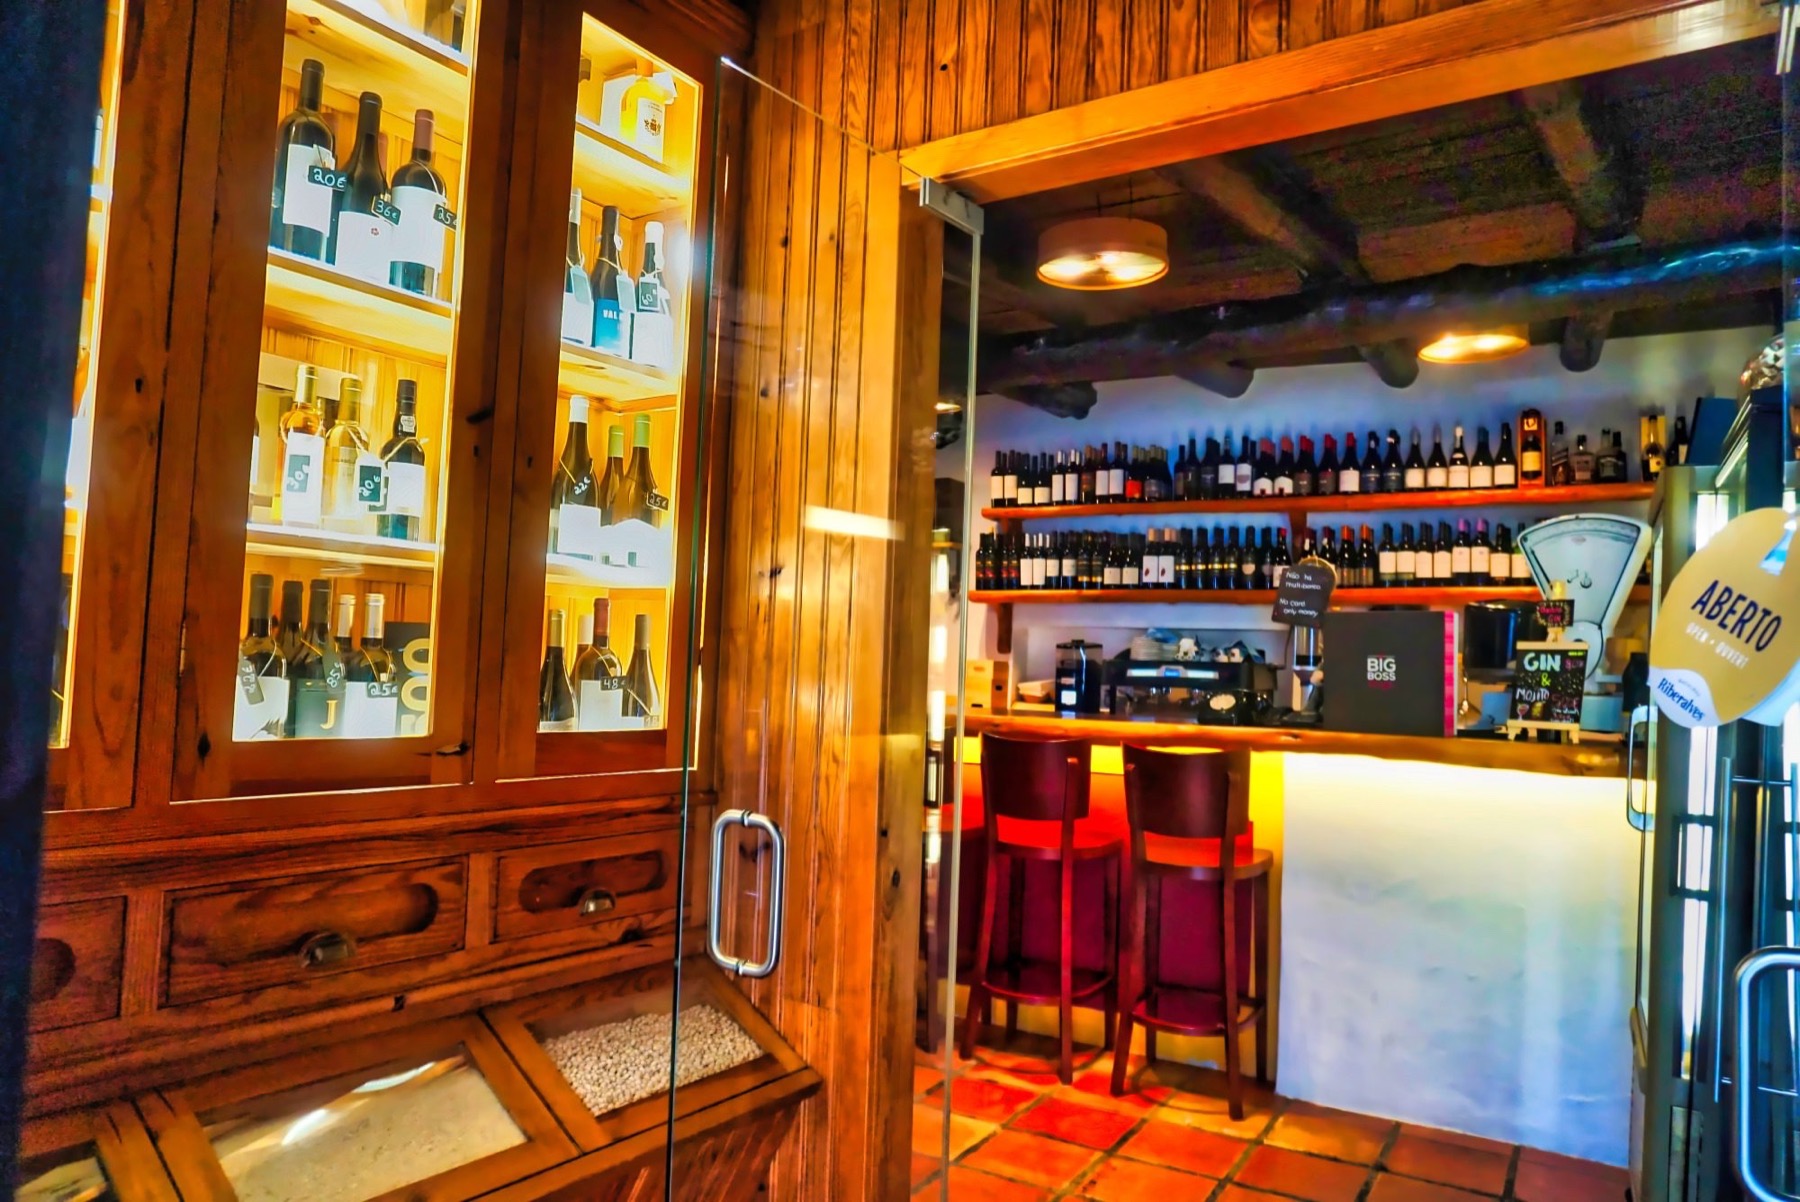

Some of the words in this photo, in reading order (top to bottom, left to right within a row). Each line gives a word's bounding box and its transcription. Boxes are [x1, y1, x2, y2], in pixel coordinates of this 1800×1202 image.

[313, 168, 347, 188] 20€
[376, 200, 397, 219] 36€
[573, 476, 591, 495] 22€
[1690, 579, 1783, 653] ABERTO
[1685, 622, 1709, 644] OPEN
[1367, 658, 1397, 672] BIG
[1523, 652, 1562, 672] GIN
[1367, 672, 1397, 682] BOSS
[1541, 672, 1551, 687] &
[1657, 677, 1706, 722] Riberalves
